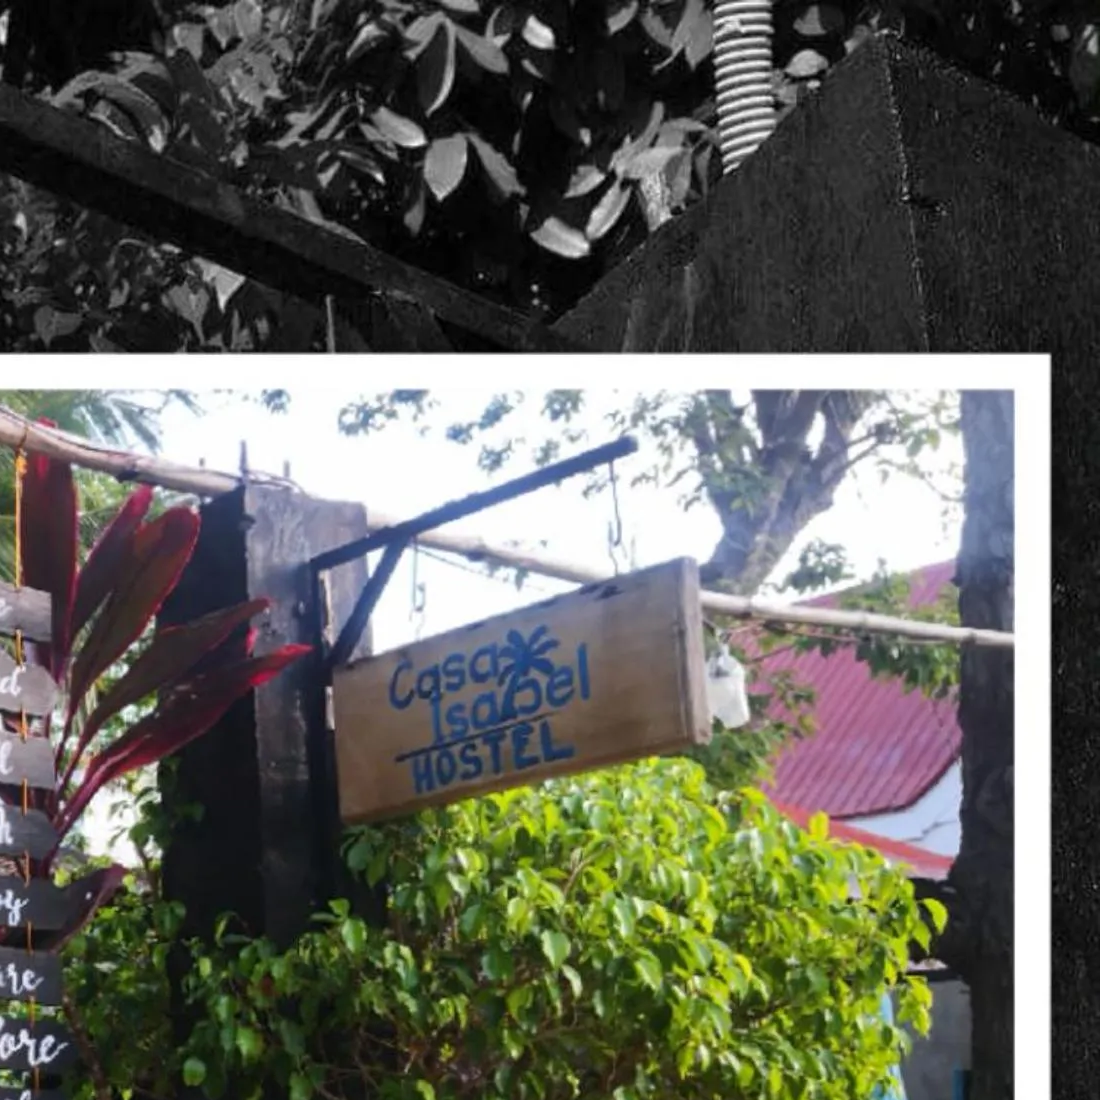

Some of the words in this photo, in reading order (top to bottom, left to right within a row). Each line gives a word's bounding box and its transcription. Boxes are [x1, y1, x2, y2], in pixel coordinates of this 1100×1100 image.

[389, 643, 500, 710] Casa
[430, 642, 591, 745] Isabel
[412, 721, 576, 795] HOSTEL
